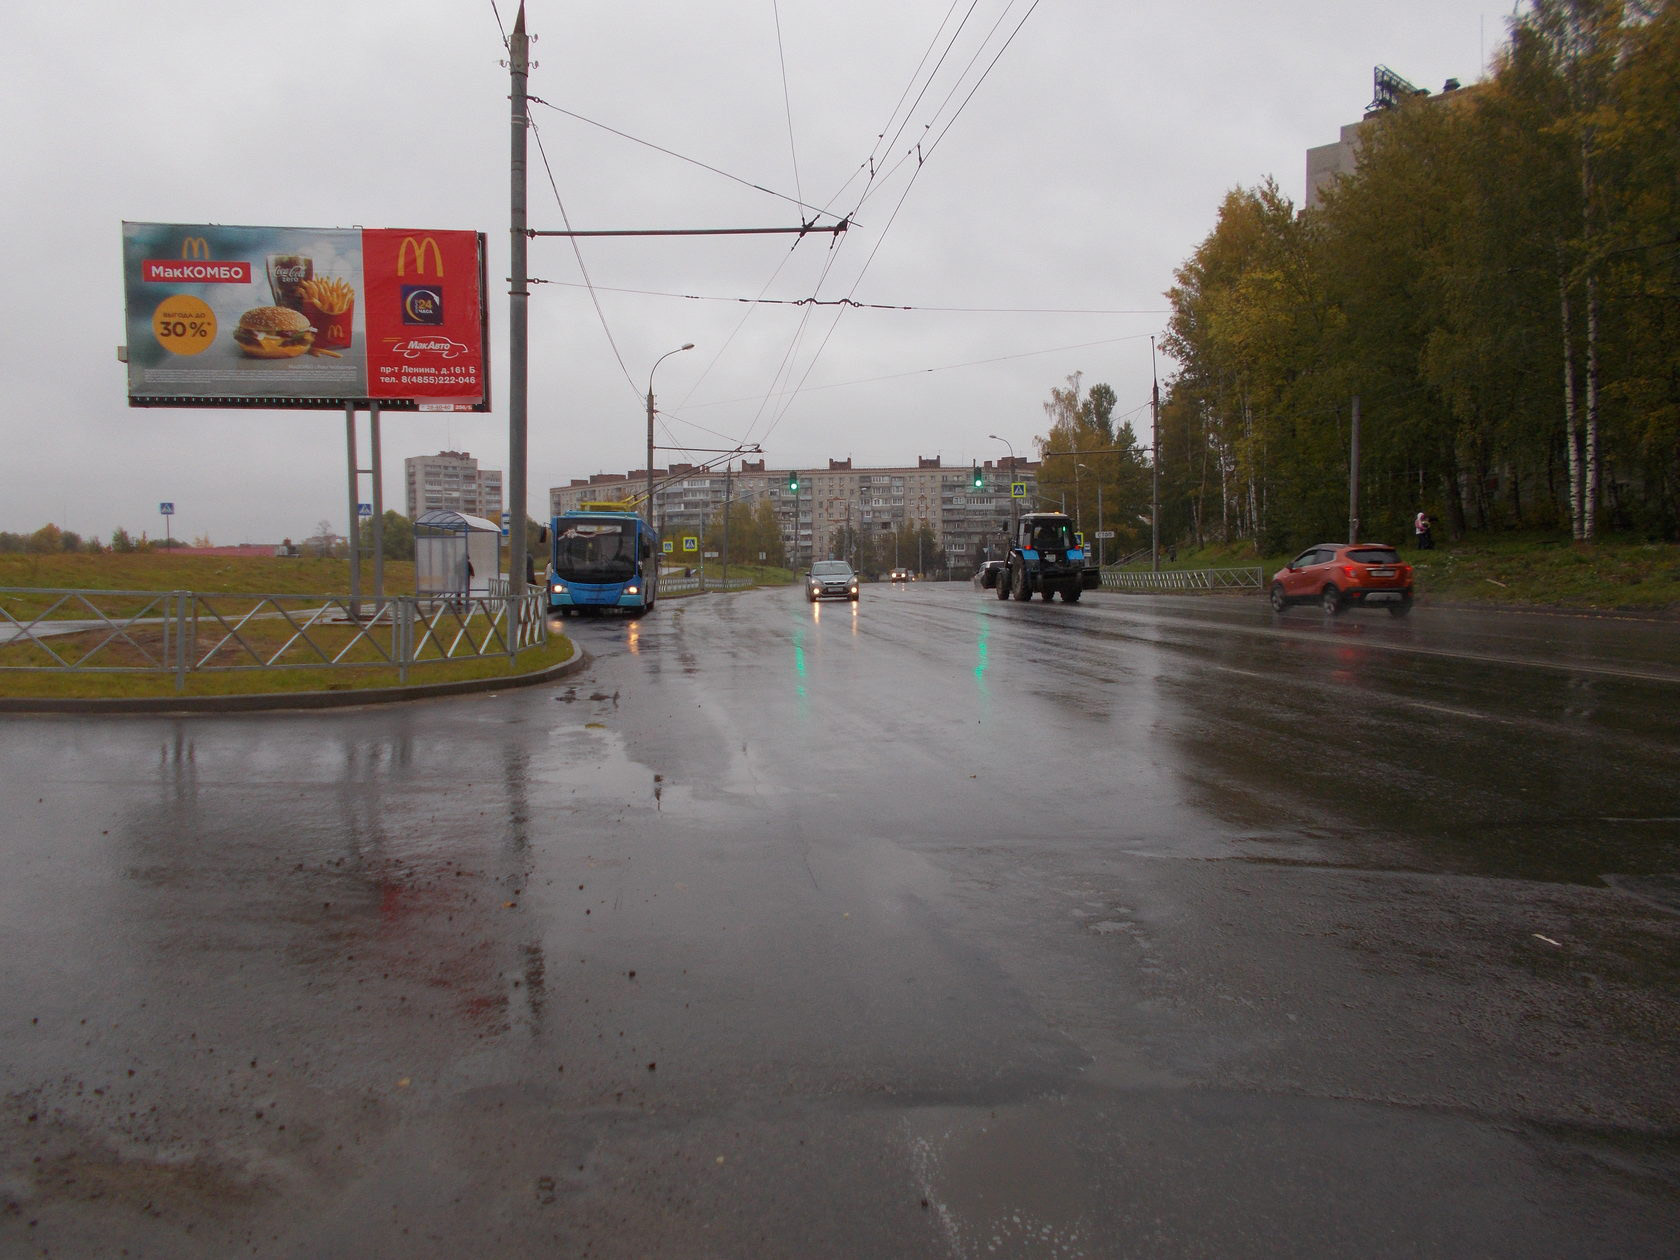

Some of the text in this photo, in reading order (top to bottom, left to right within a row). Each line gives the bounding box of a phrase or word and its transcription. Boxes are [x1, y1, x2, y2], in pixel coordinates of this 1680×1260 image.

[151, 265, 243, 279] МакКОМБО
[418, 299, 433, 310] 24
[380, 366, 399, 374] пр-т
[401, 365, 438, 375] Ленина,
